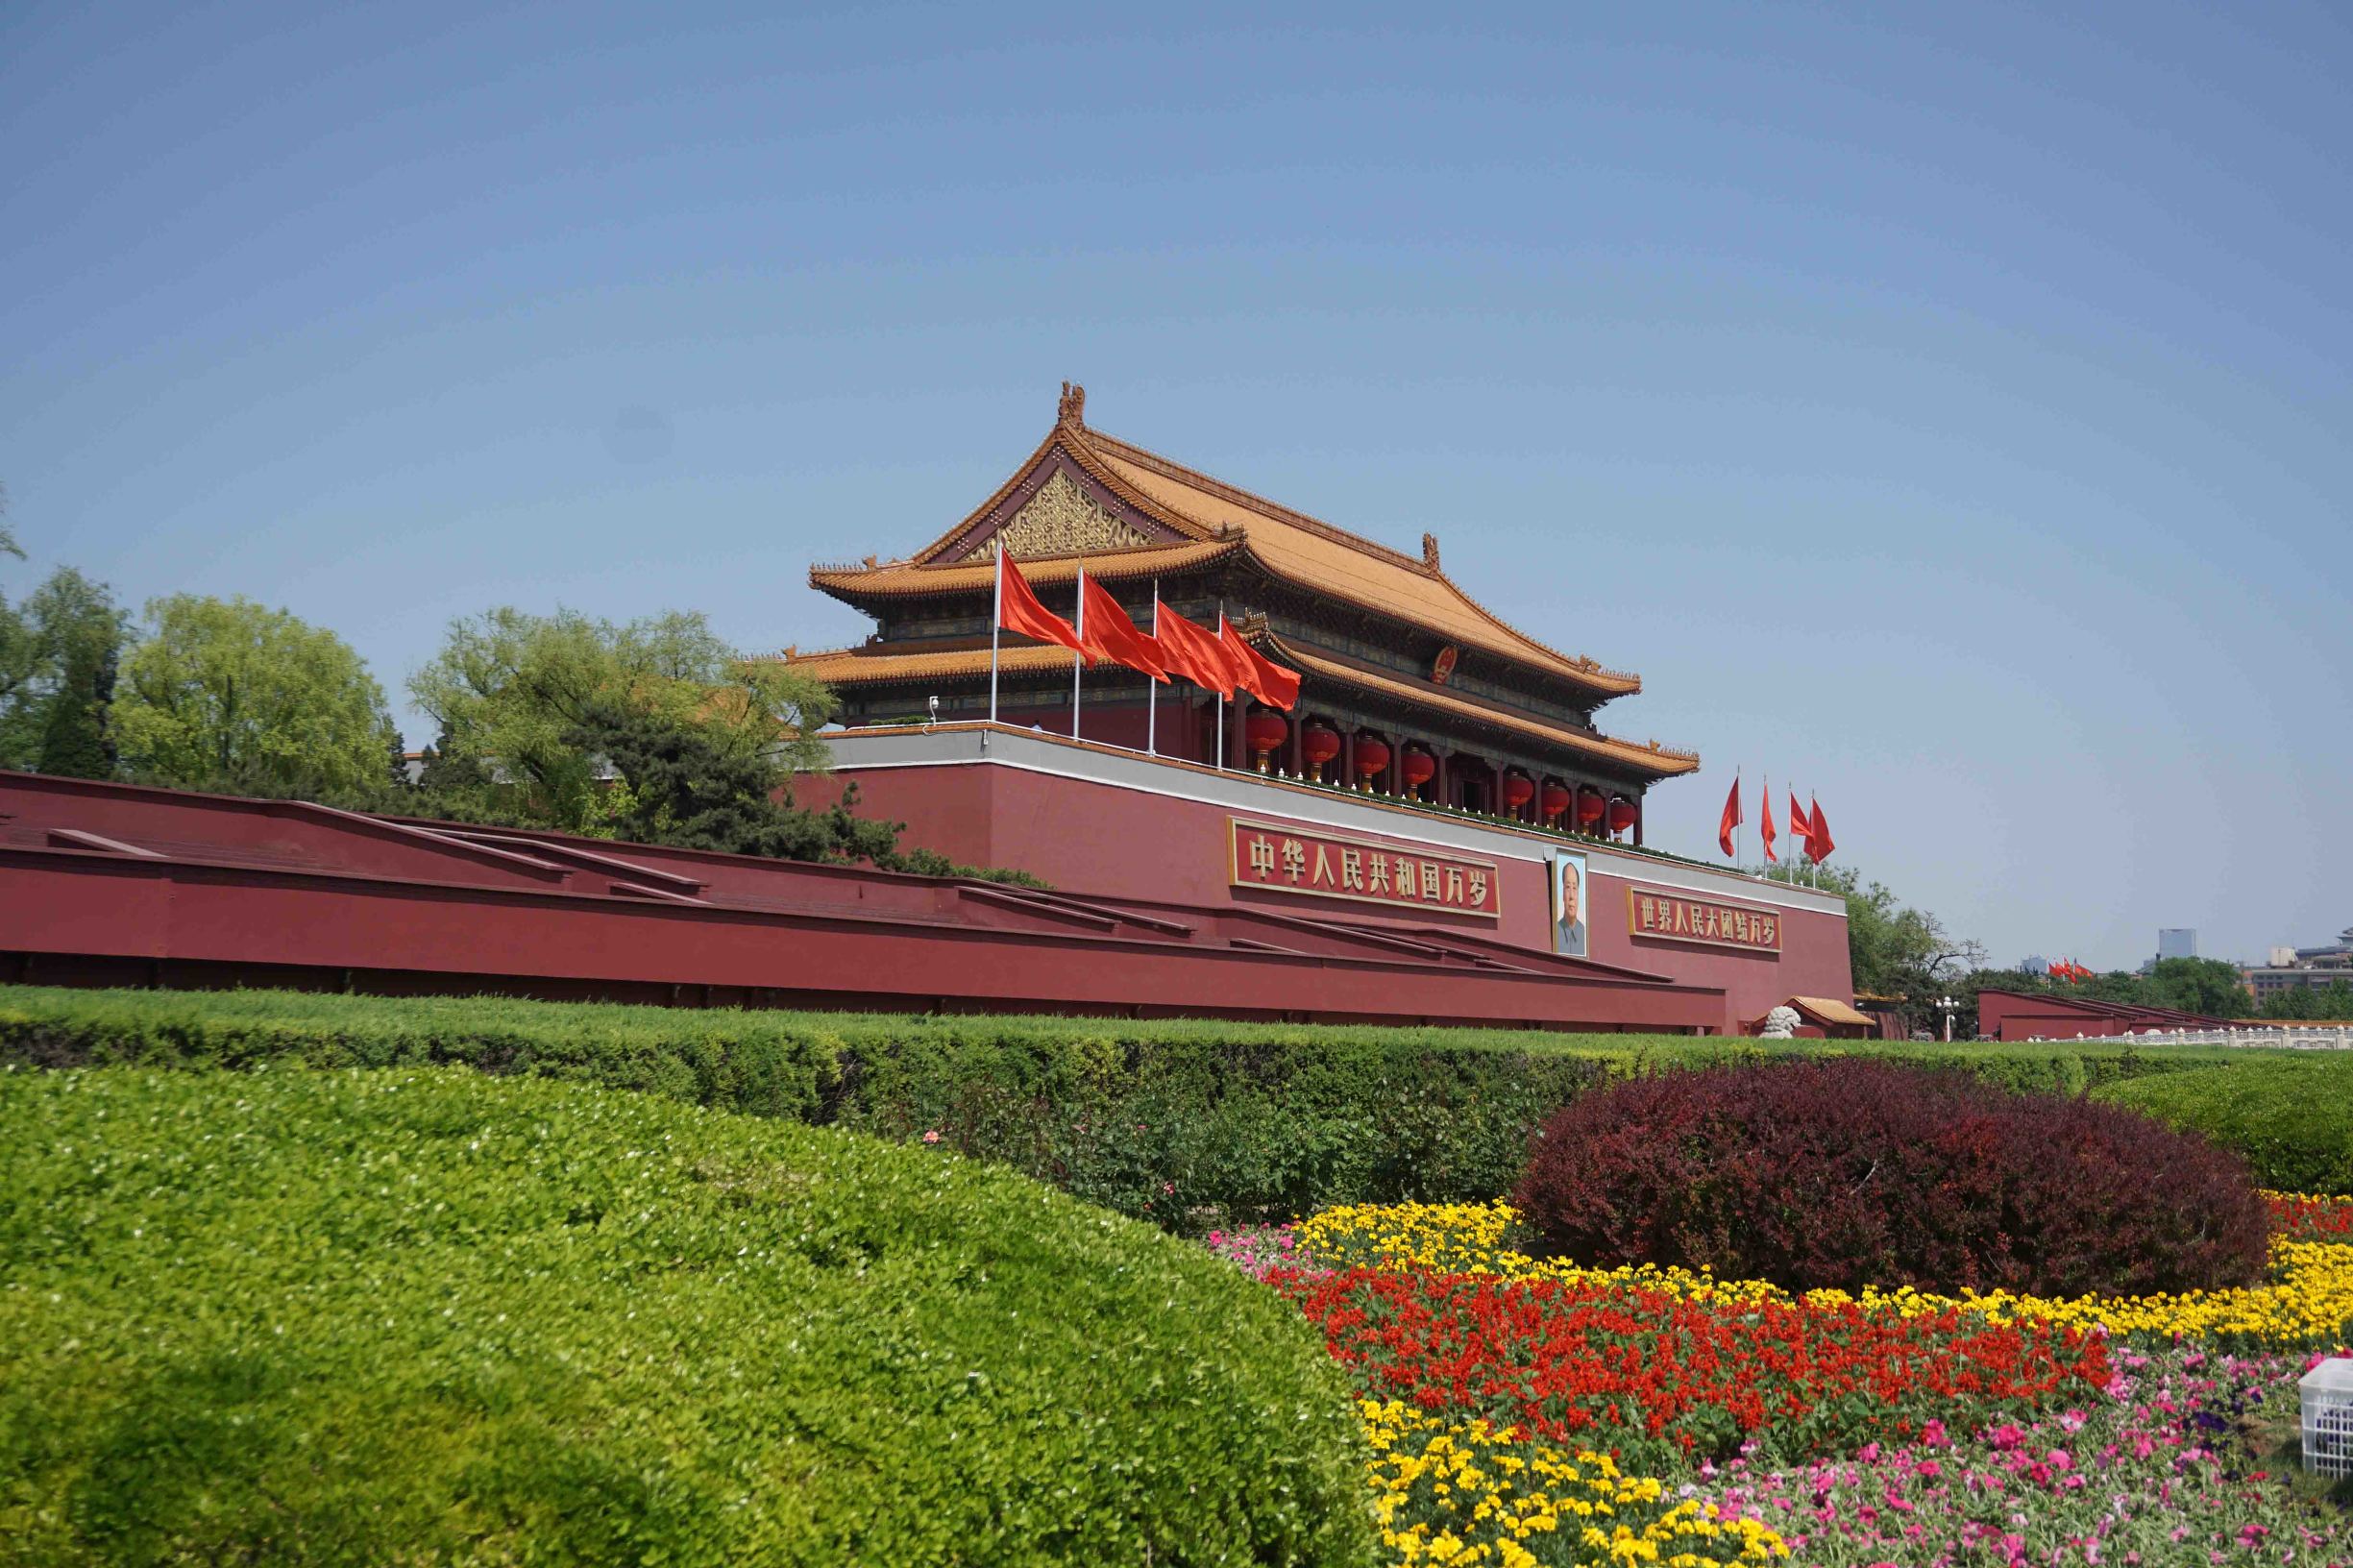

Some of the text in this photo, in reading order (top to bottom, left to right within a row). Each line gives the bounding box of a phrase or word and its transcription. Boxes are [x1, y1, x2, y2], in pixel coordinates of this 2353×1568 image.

[1249, 833, 1487, 906] 中华人民共和国万岁
[1640, 896, 1775, 944] 世界人民大团结万岁
